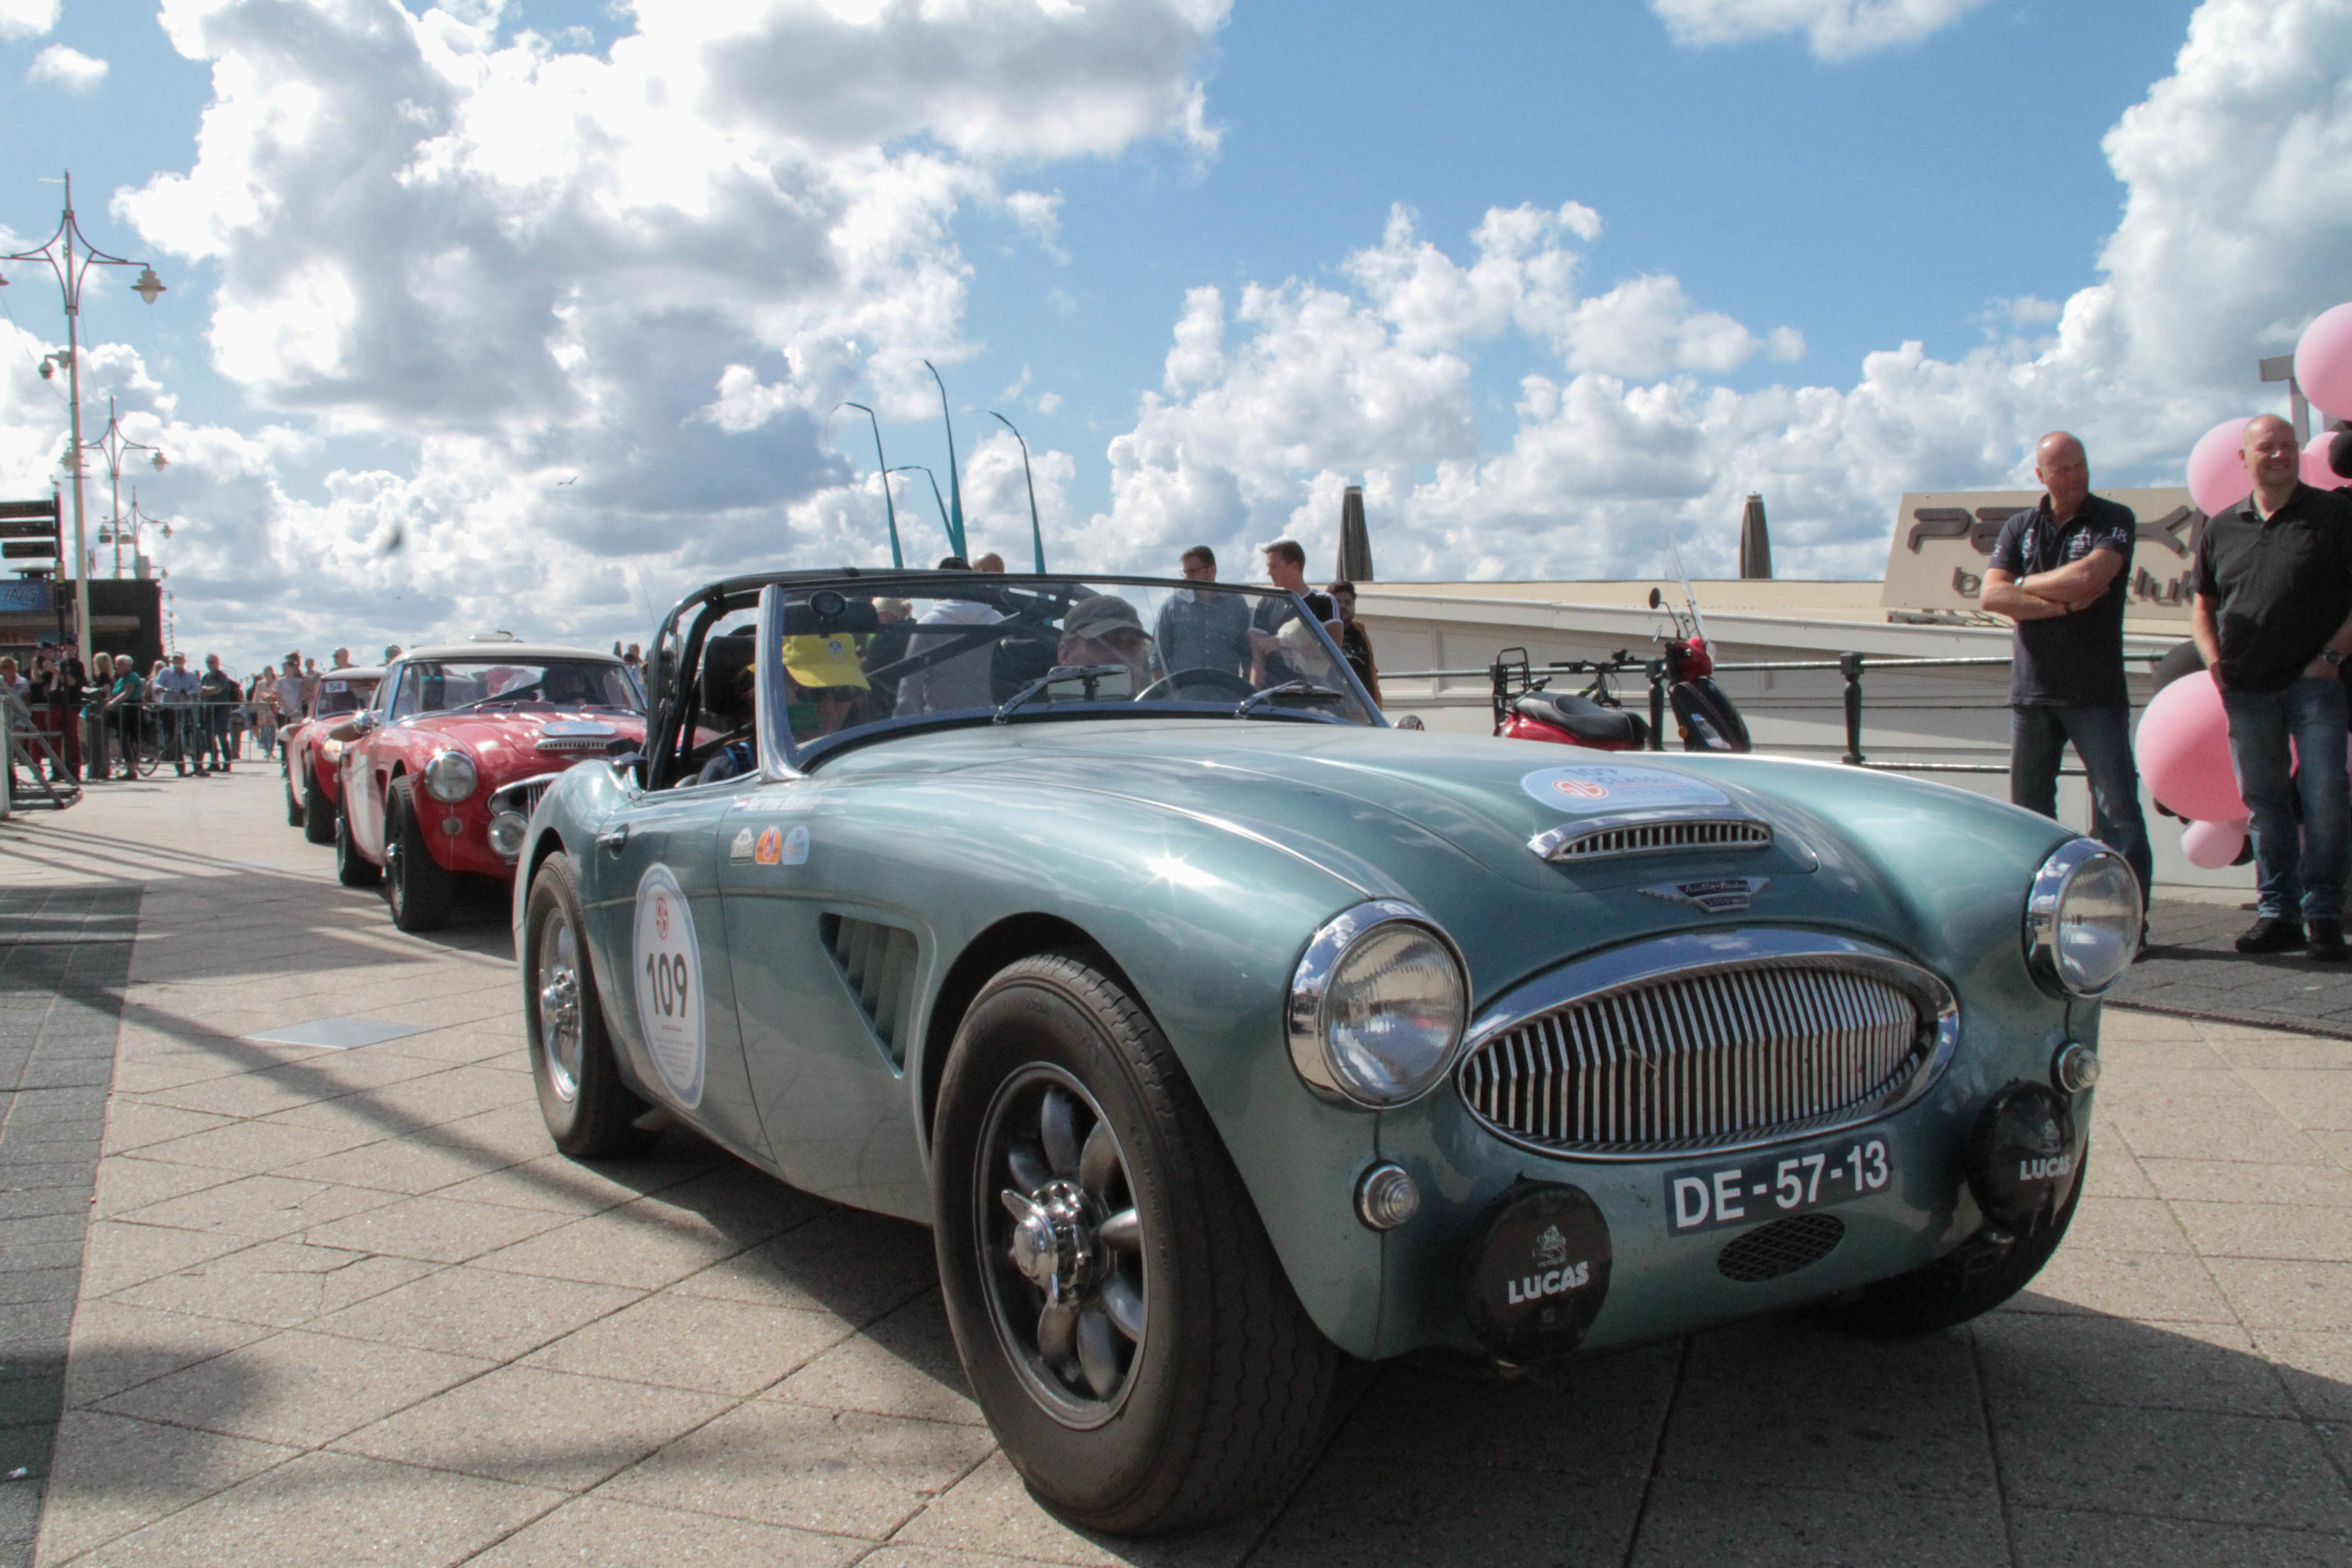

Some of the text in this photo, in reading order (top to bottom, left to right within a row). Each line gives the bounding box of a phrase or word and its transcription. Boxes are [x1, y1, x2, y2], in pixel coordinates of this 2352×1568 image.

[1564, 768, 1618, 776] 109
[646, 952, 688, 1018] 109
[1673, 1140, 1888, 1228] DE-57-13
[2020, 1154, 2071, 1181] LUCAS
[1508, 1260, 1589, 1305] LUCAS
